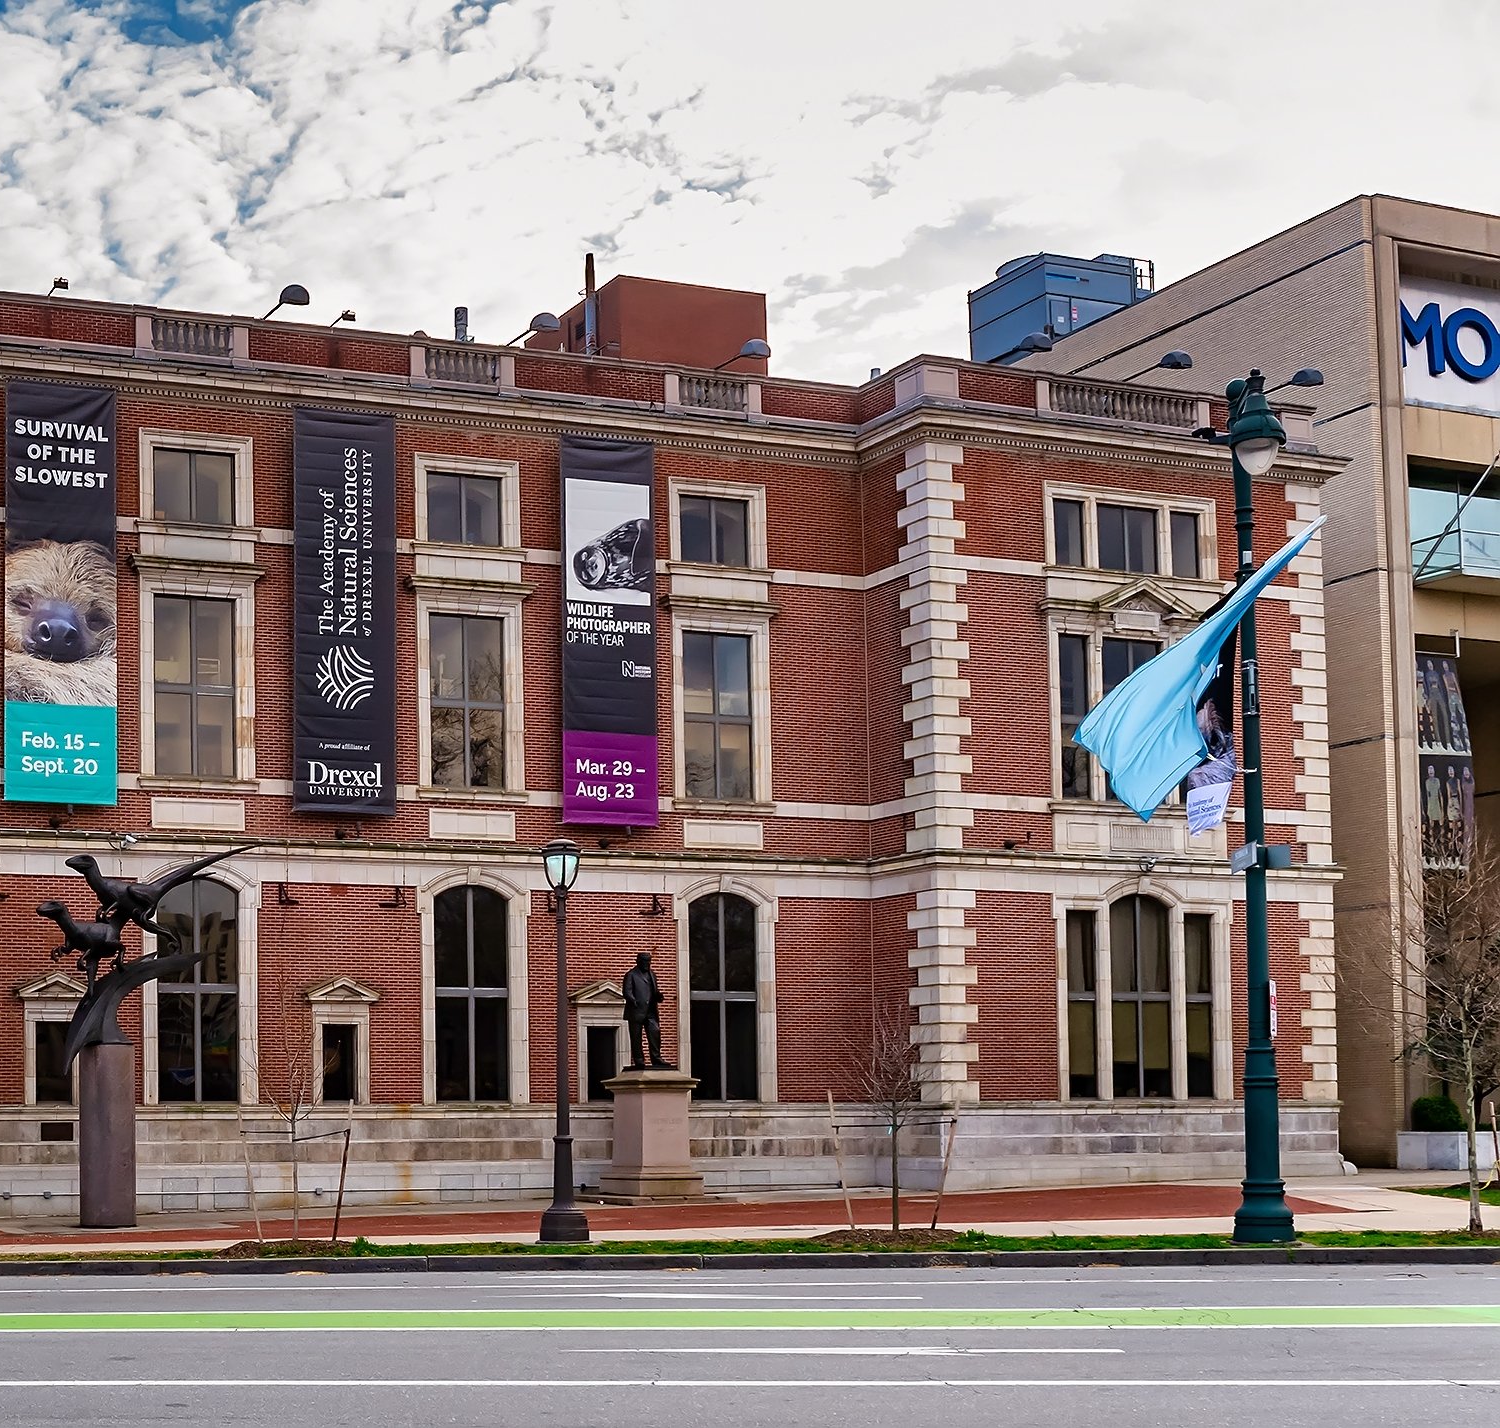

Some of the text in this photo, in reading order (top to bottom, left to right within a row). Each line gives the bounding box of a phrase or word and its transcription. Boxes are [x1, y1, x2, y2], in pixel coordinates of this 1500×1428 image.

[14, 418, 109, 442] SURVIVAL
[27, 443, 96, 465] OF THE
[14, 466, 108, 488] SLOWEST
[338, 447, 357, 636] Natural Sciences
[362, 449, 372, 637] of DREXEL UNIVERSITY
[318, 488, 338, 635] The Academy of
[566, 602, 614, 618] WILDLIFE
[566, 616, 651, 634] PHOTOGRAPHER
[566, 630, 624, 647] OF THE YEAR
[22, 731, 60, 749] Feb.
[63, 733, 85, 750] 15
[21, 755, 98, 777] Sept. 20
[307, 760, 383, 788] Drexel
[576, 758, 609, 775] Mar.
[612, 760, 633, 776] 29
[309, 785, 381, 798] UNIVERSITY
[575, 781, 635, 802] Aug. 23
